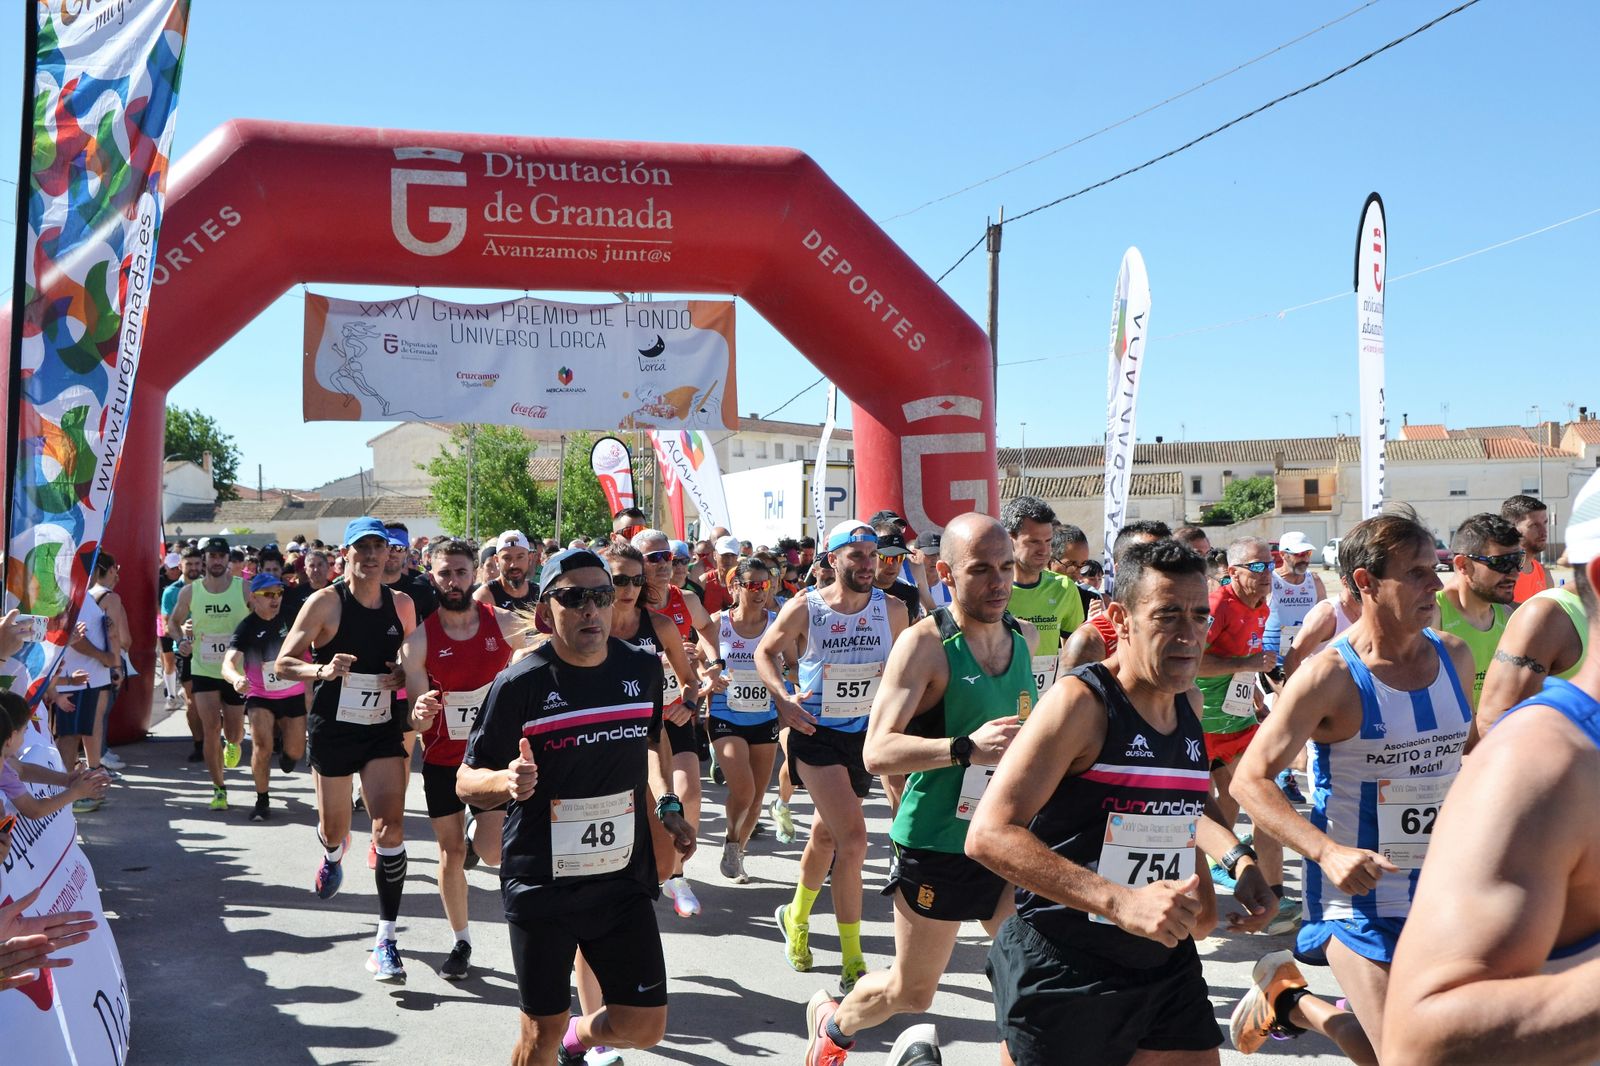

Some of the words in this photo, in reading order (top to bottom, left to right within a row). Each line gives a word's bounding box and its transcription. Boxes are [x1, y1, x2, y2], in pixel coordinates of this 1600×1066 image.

[482, 152, 672, 187] Diputación
[483, 190, 523, 223] de
[529, 193, 674, 230] Granada
[482, 239, 598, 261] Avanzamos
[602, 244, 672, 263] junt@s
[802, 229, 926, 352] DEPORTES
[359, 298, 420, 321] XXXV
[432, 301, 490, 322] GRAN
[502, 302, 579, 326] PREMIO
[590, 308, 614, 327] DE
[625, 304, 692, 330] FONDO
[401, 339, 438, 349] Diputación
[451, 322, 539, 349] UNIVERSO
[550, 327, 607, 349] LORCA
[96, 214, 152, 493] www.turgranada.es
[410, 347, 438, 356] Granada
[456, 371, 500, 381] Cruzcampo
[1280, 596, 1313, 604] MARACENA
[204, 604, 231, 614] FILA
[822, 635, 881, 650] MARACENA
[733, 685, 768, 700] 3068
[836, 680, 871, 698] 557
[361, 691, 381, 707] 77
[1384, 737, 1431, 751] Asociación
[1366, 749, 1421, 765] PAZITO
[1424, 750, 1432, 759] a
[1410, 760, 1443, 776] Motril
[1401, 805, 1442, 835] 62
[581, 821, 616, 848] 48
[1128, 852, 1181, 885] 754
